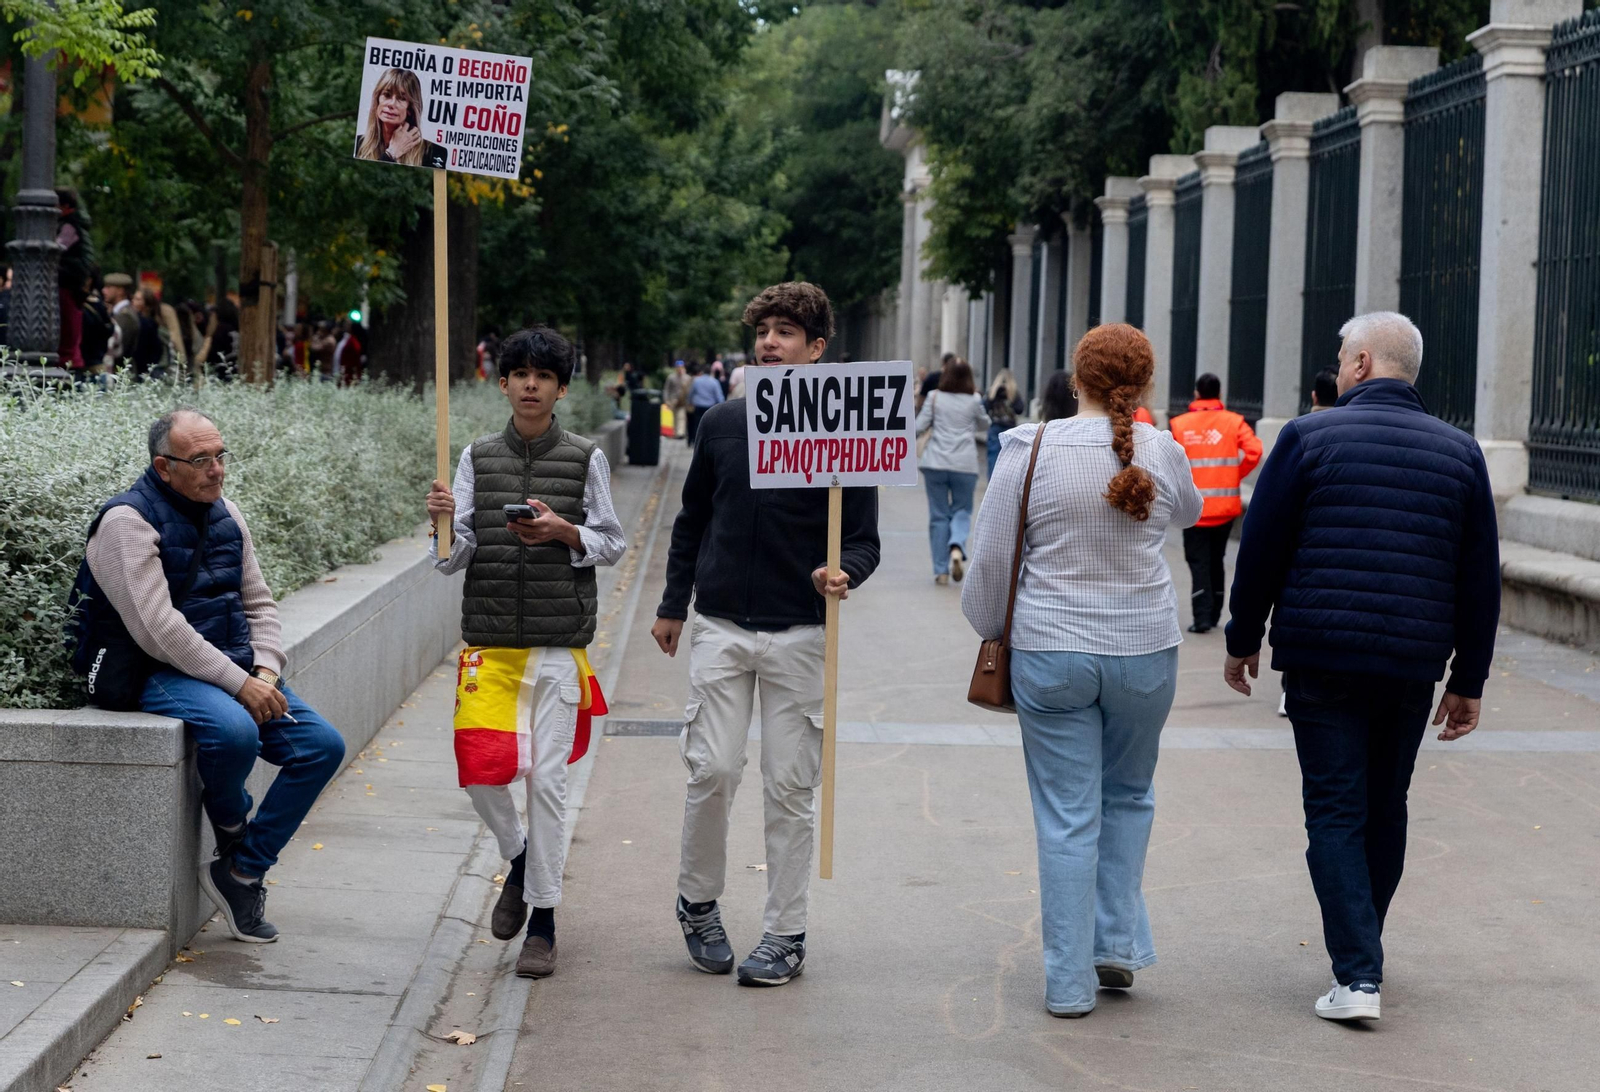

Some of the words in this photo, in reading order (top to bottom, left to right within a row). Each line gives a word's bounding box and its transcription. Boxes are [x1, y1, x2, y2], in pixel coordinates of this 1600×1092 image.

[369, 47, 437, 73] BEGOÑA
[442, 56, 454, 75] O
[458, 58, 527, 84] BEGOÑO
[430, 79, 453, 97] ME
[456, 81, 523, 102] IMPORTA
[427, 99, 458, 126] UN
[462, 104, 522, 137] COÑO
[436, 129, 443, 143] 5
[445, 130, 518, 153] IMPUTACIONES
[458, 149, 516, 174] EXPLICACIONES
[755, 369, 907, 435] SÁNCHEZ
[757, 437, 908, 484] LPMQTPHDLGP
[88, 648, 107, 694] adidas
